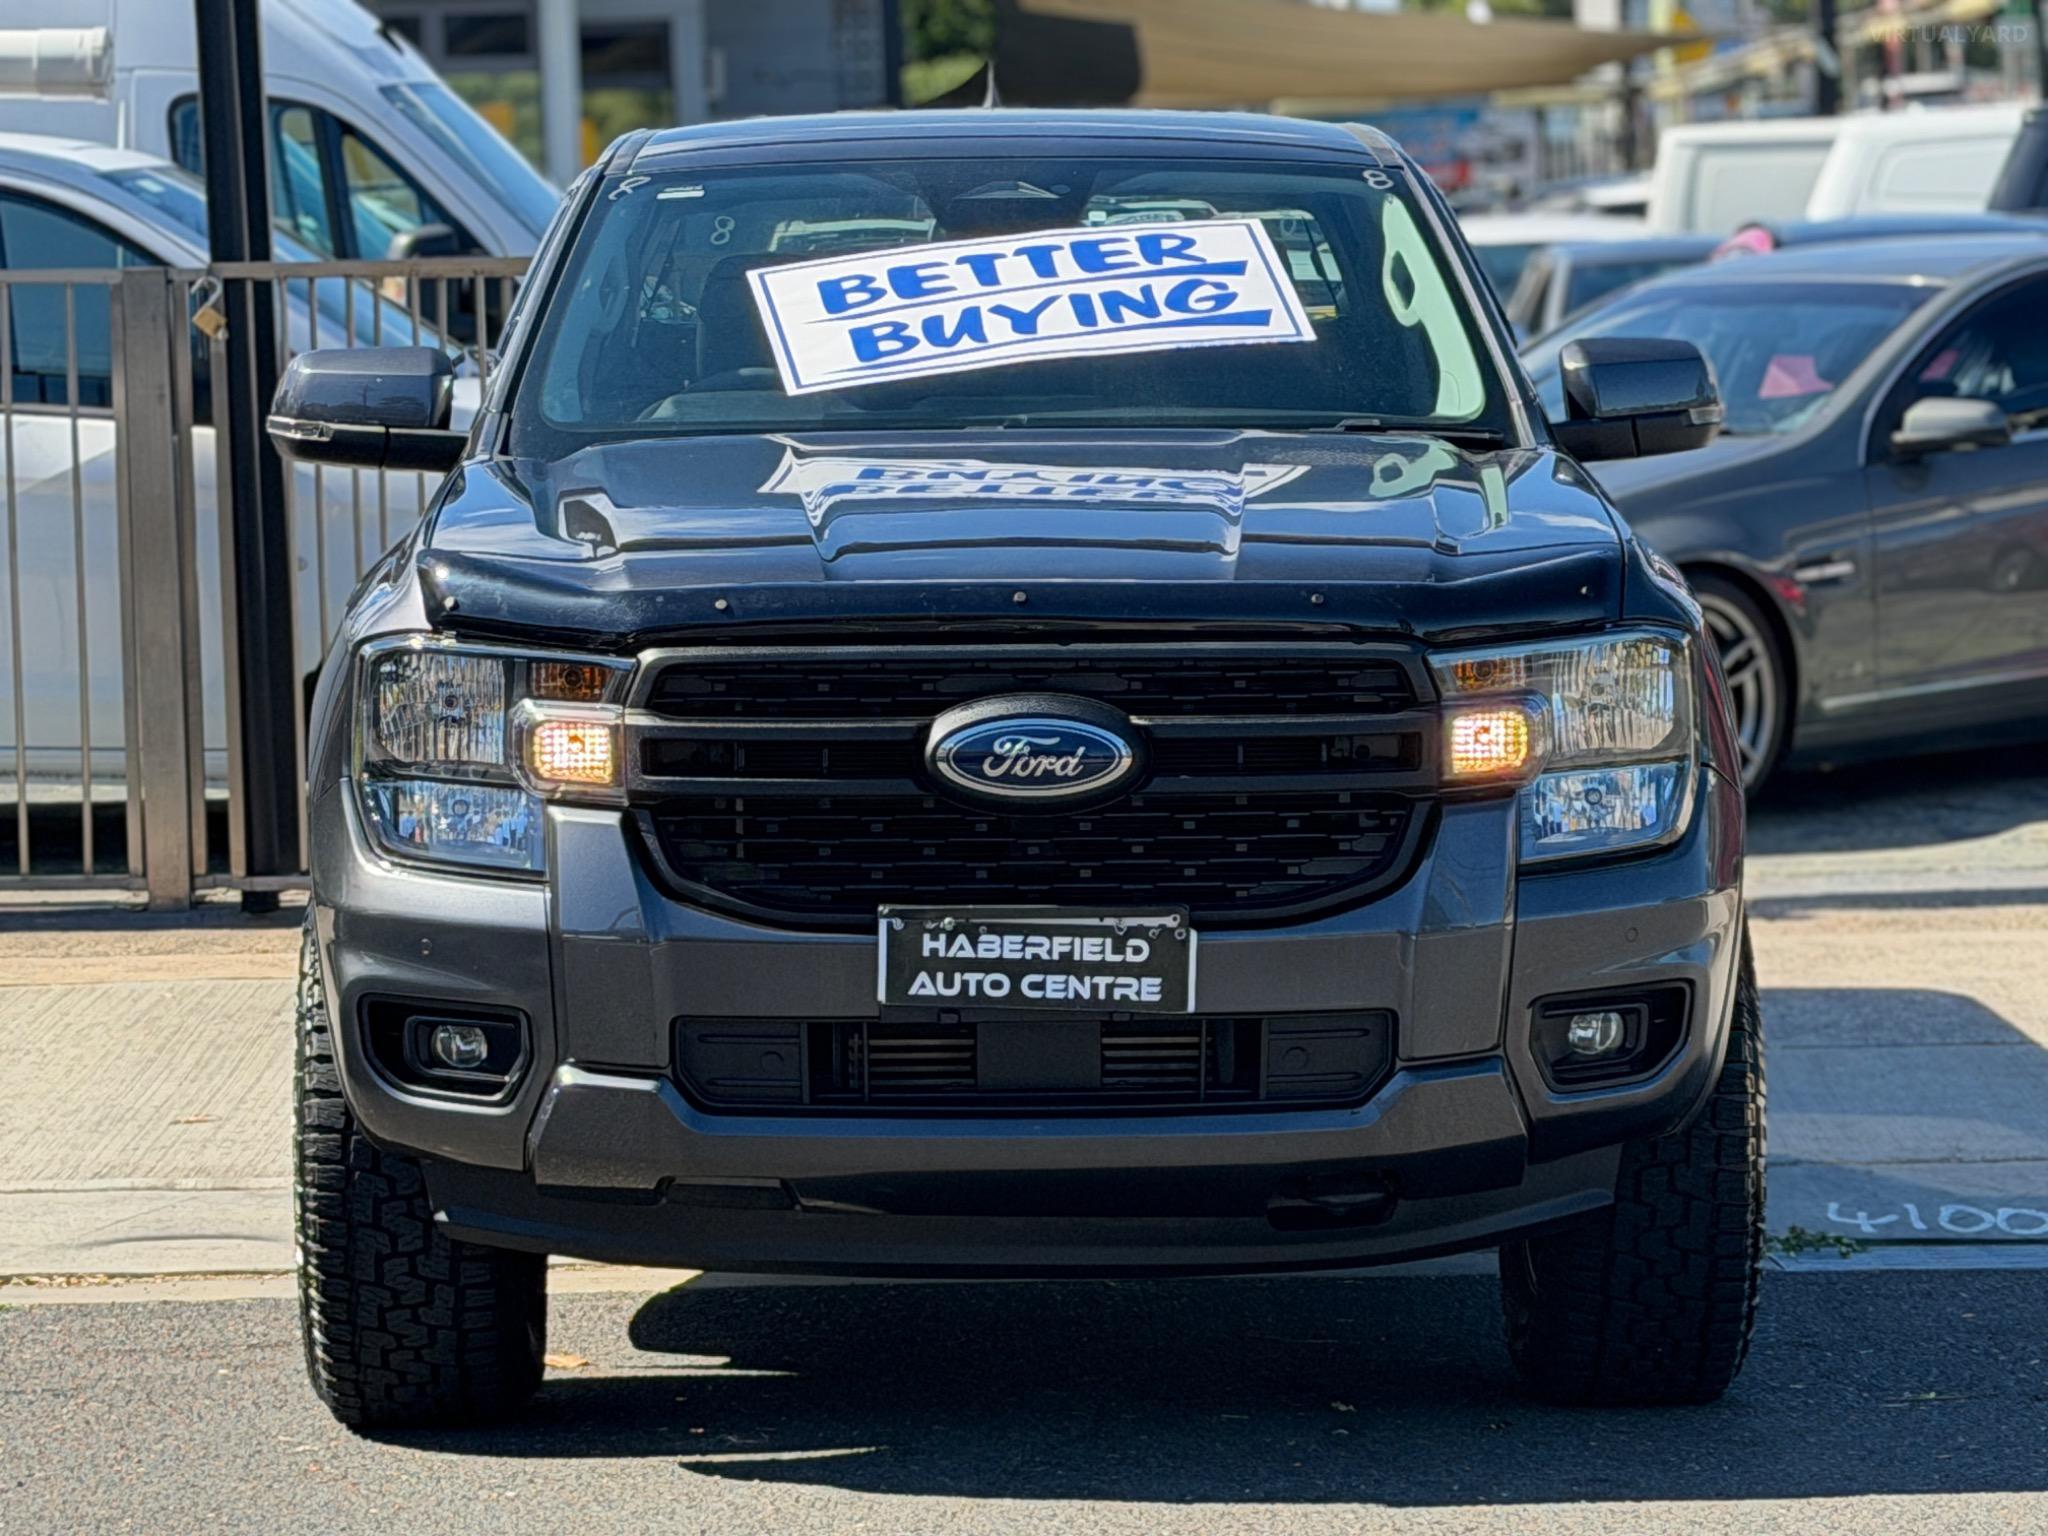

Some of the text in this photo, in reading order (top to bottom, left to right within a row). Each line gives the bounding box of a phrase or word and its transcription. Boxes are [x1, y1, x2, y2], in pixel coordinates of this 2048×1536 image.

[816, 233, 1208, 315] BETTER
[848, 279, 1239, 363] BUYING
[982, 735, 1086, 777] Ford
[922, 933, 1150, 963] HABERFIELD
[908, 971, 1163, 1001] AUTO CENTRE
